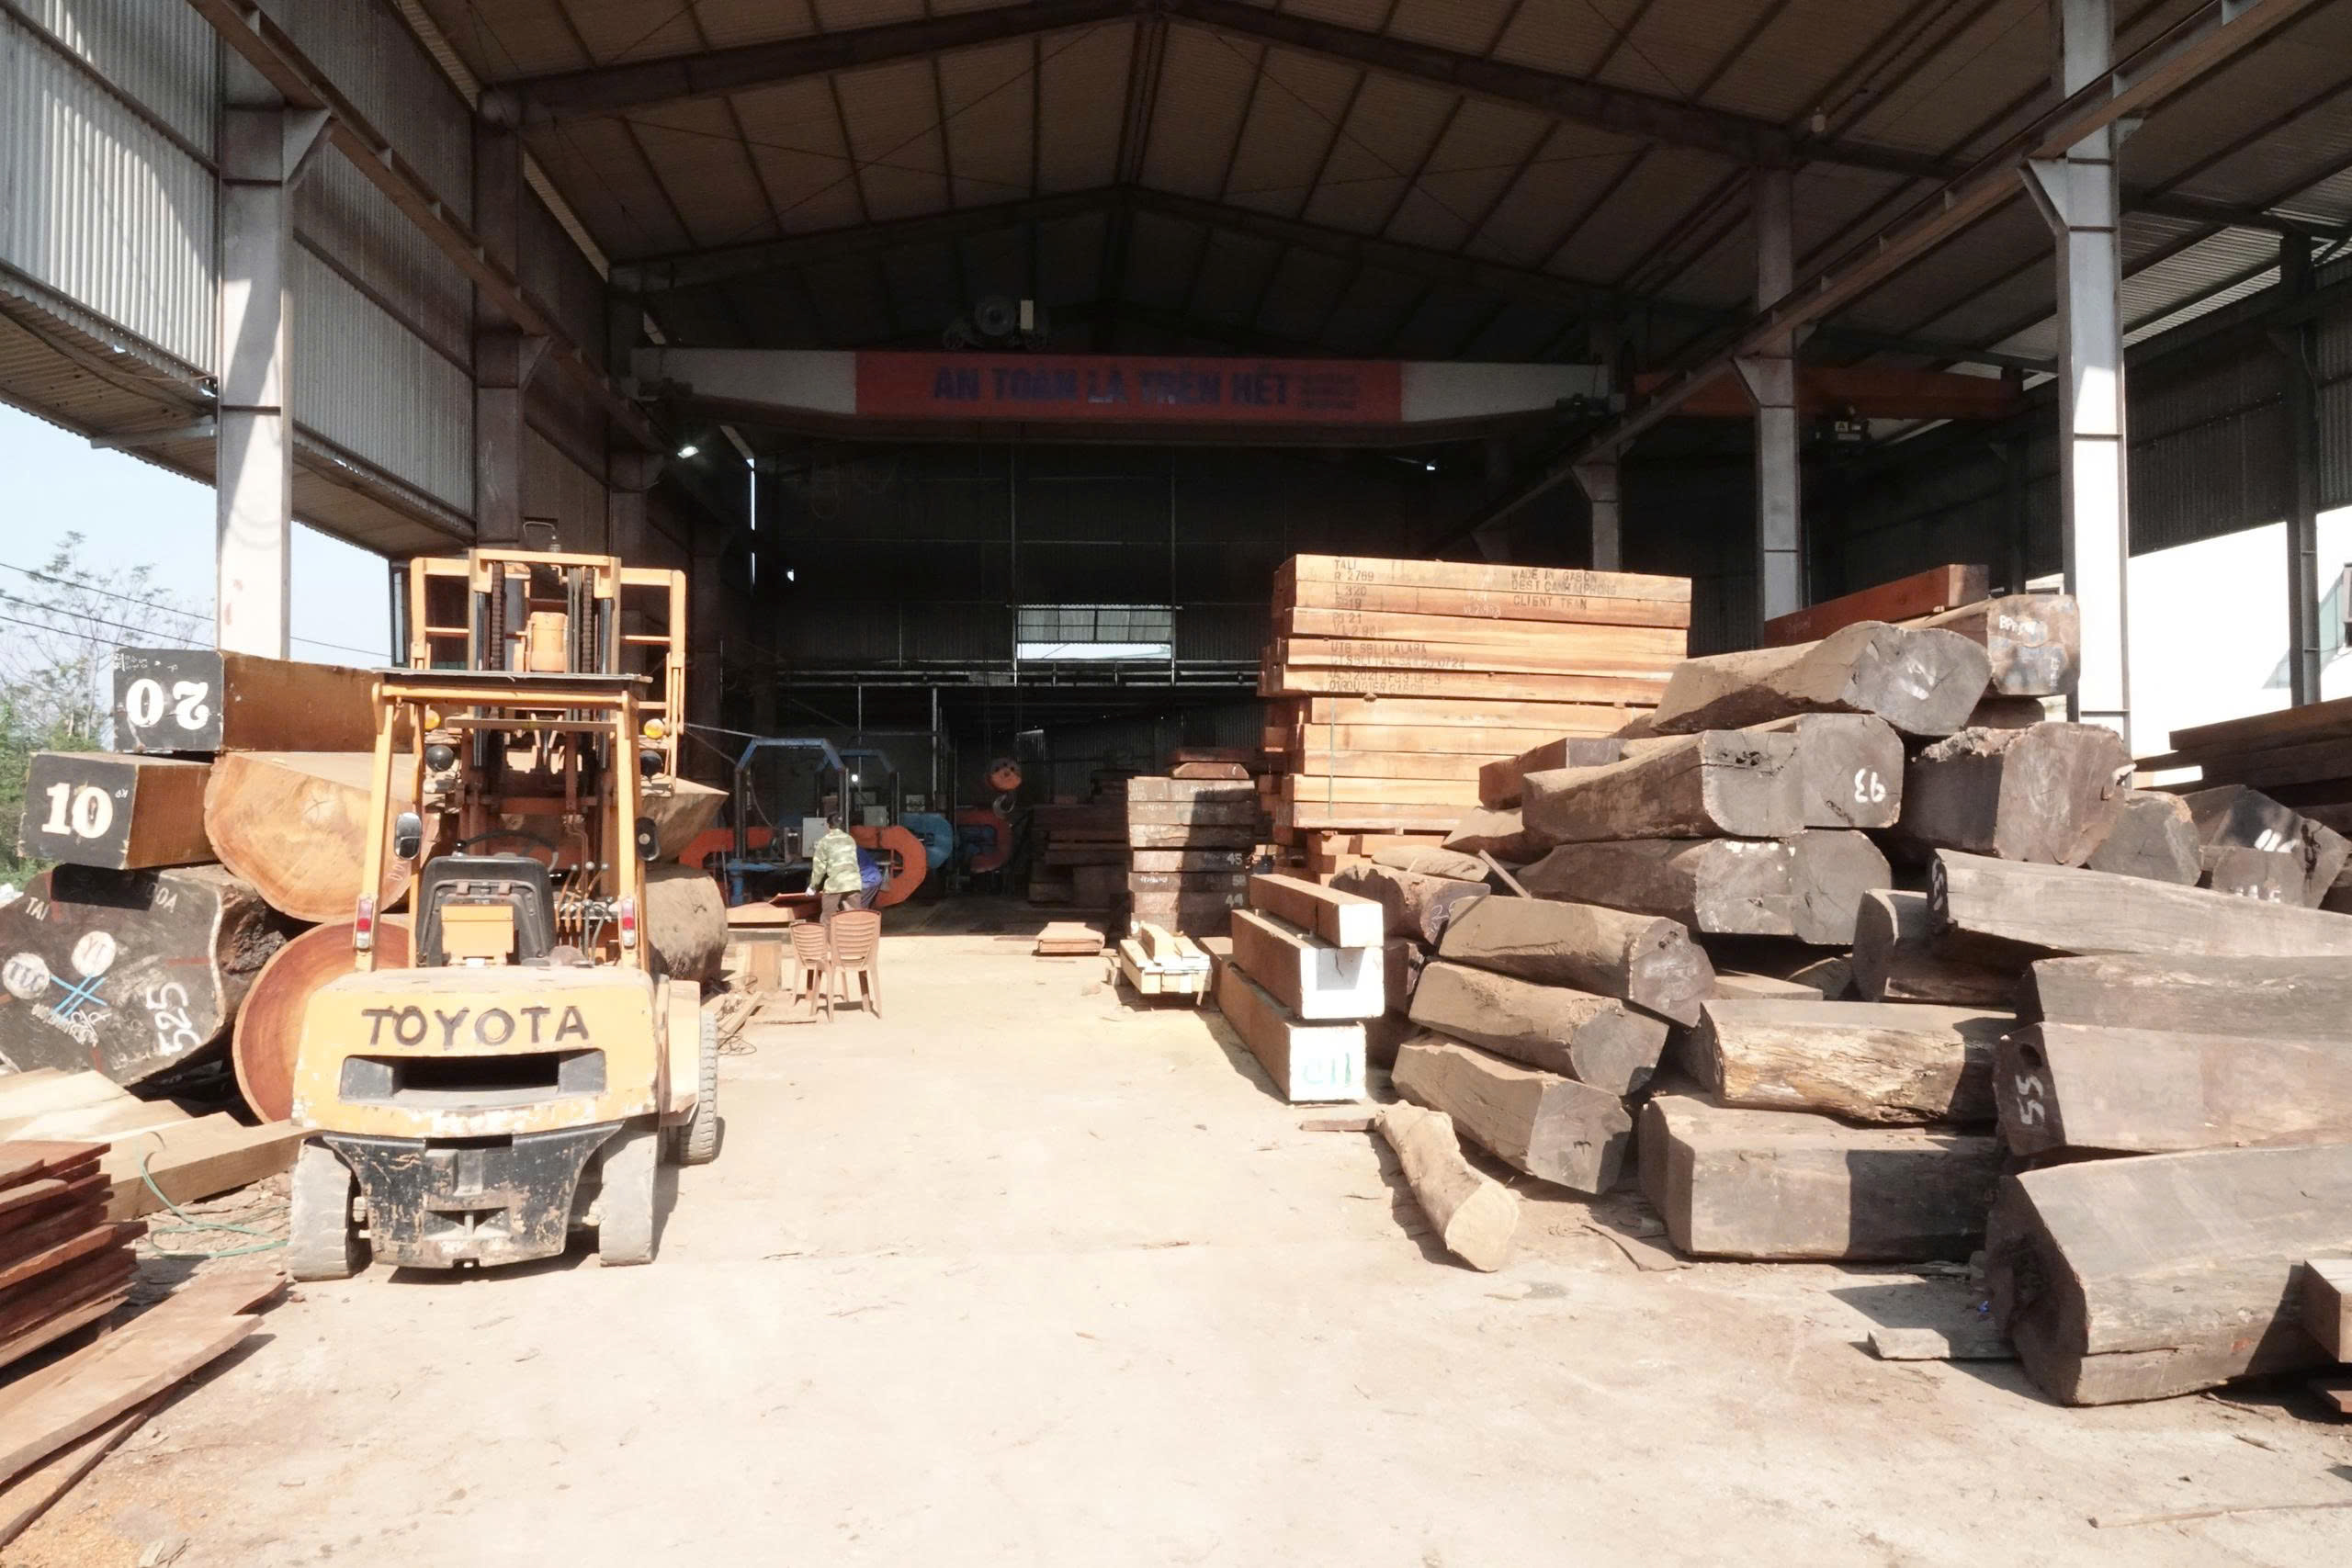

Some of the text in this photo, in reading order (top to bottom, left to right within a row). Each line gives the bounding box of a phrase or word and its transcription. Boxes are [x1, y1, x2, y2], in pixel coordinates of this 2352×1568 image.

[1513, 594, 1554, 608] CLIENT
[40, 782, 114, 840] 10
[145, 981, 203, 1057] 525
[361, 1006, 589, 1047] TOYOTA
